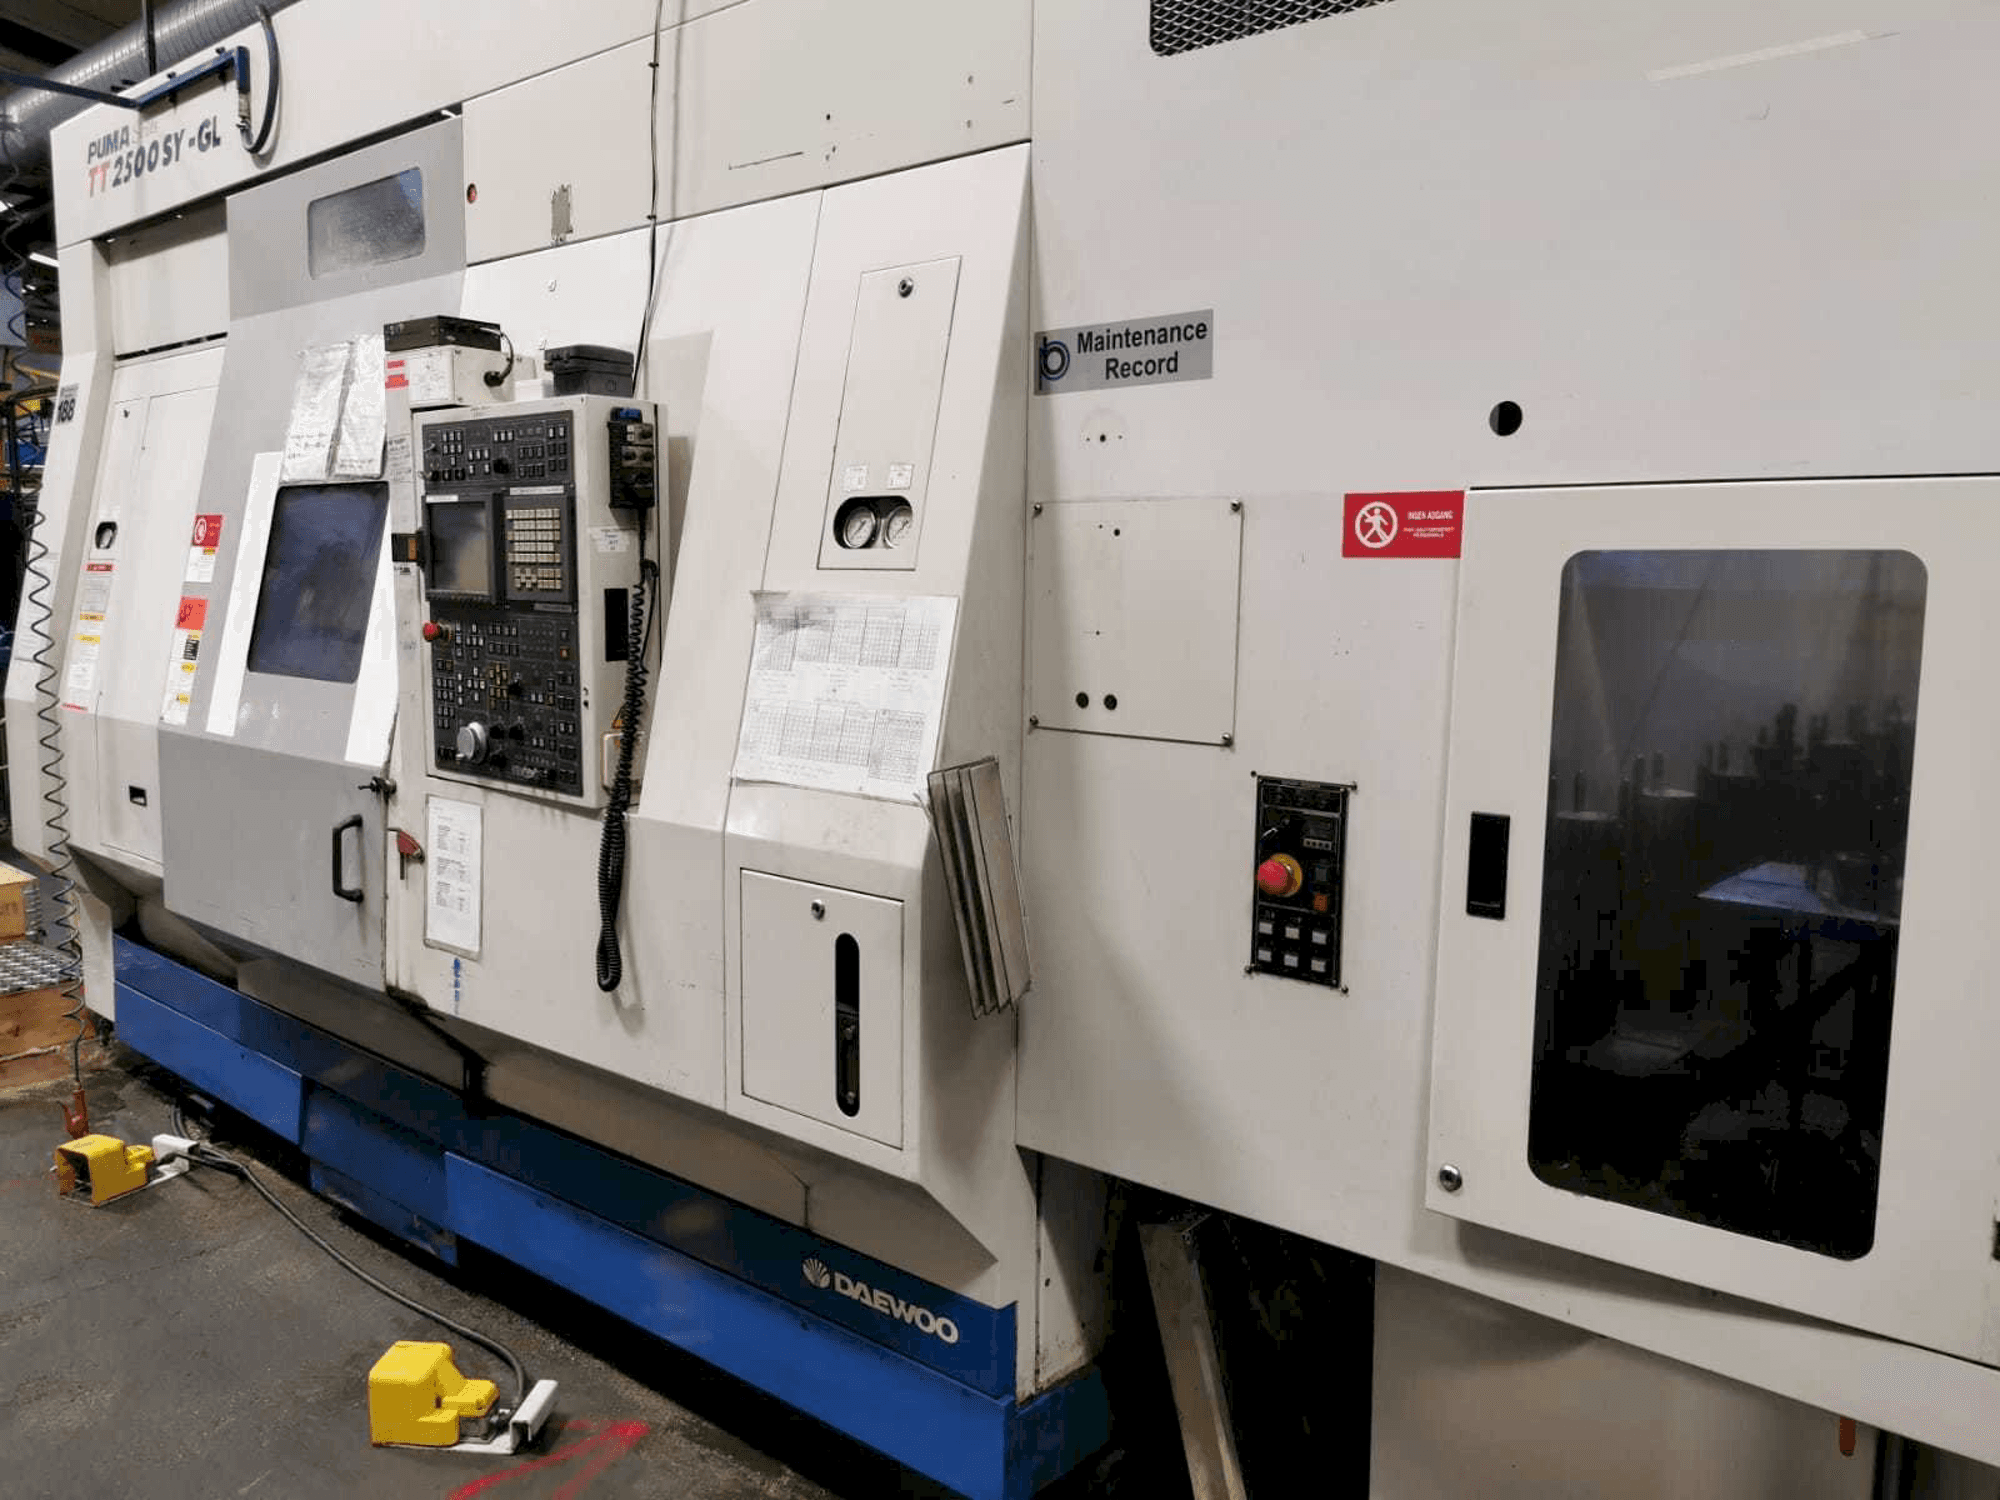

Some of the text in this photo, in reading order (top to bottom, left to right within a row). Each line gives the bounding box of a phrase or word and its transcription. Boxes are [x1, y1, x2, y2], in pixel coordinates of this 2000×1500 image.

[88, 125, 130, 164] PUMA
[88, 161, 110, 198] TT
[1077, 322, 1208, 354] Maintenance
[1105, 350, 1179, 380] Record
[834, 1270, 960, 1344] DAEWOO
